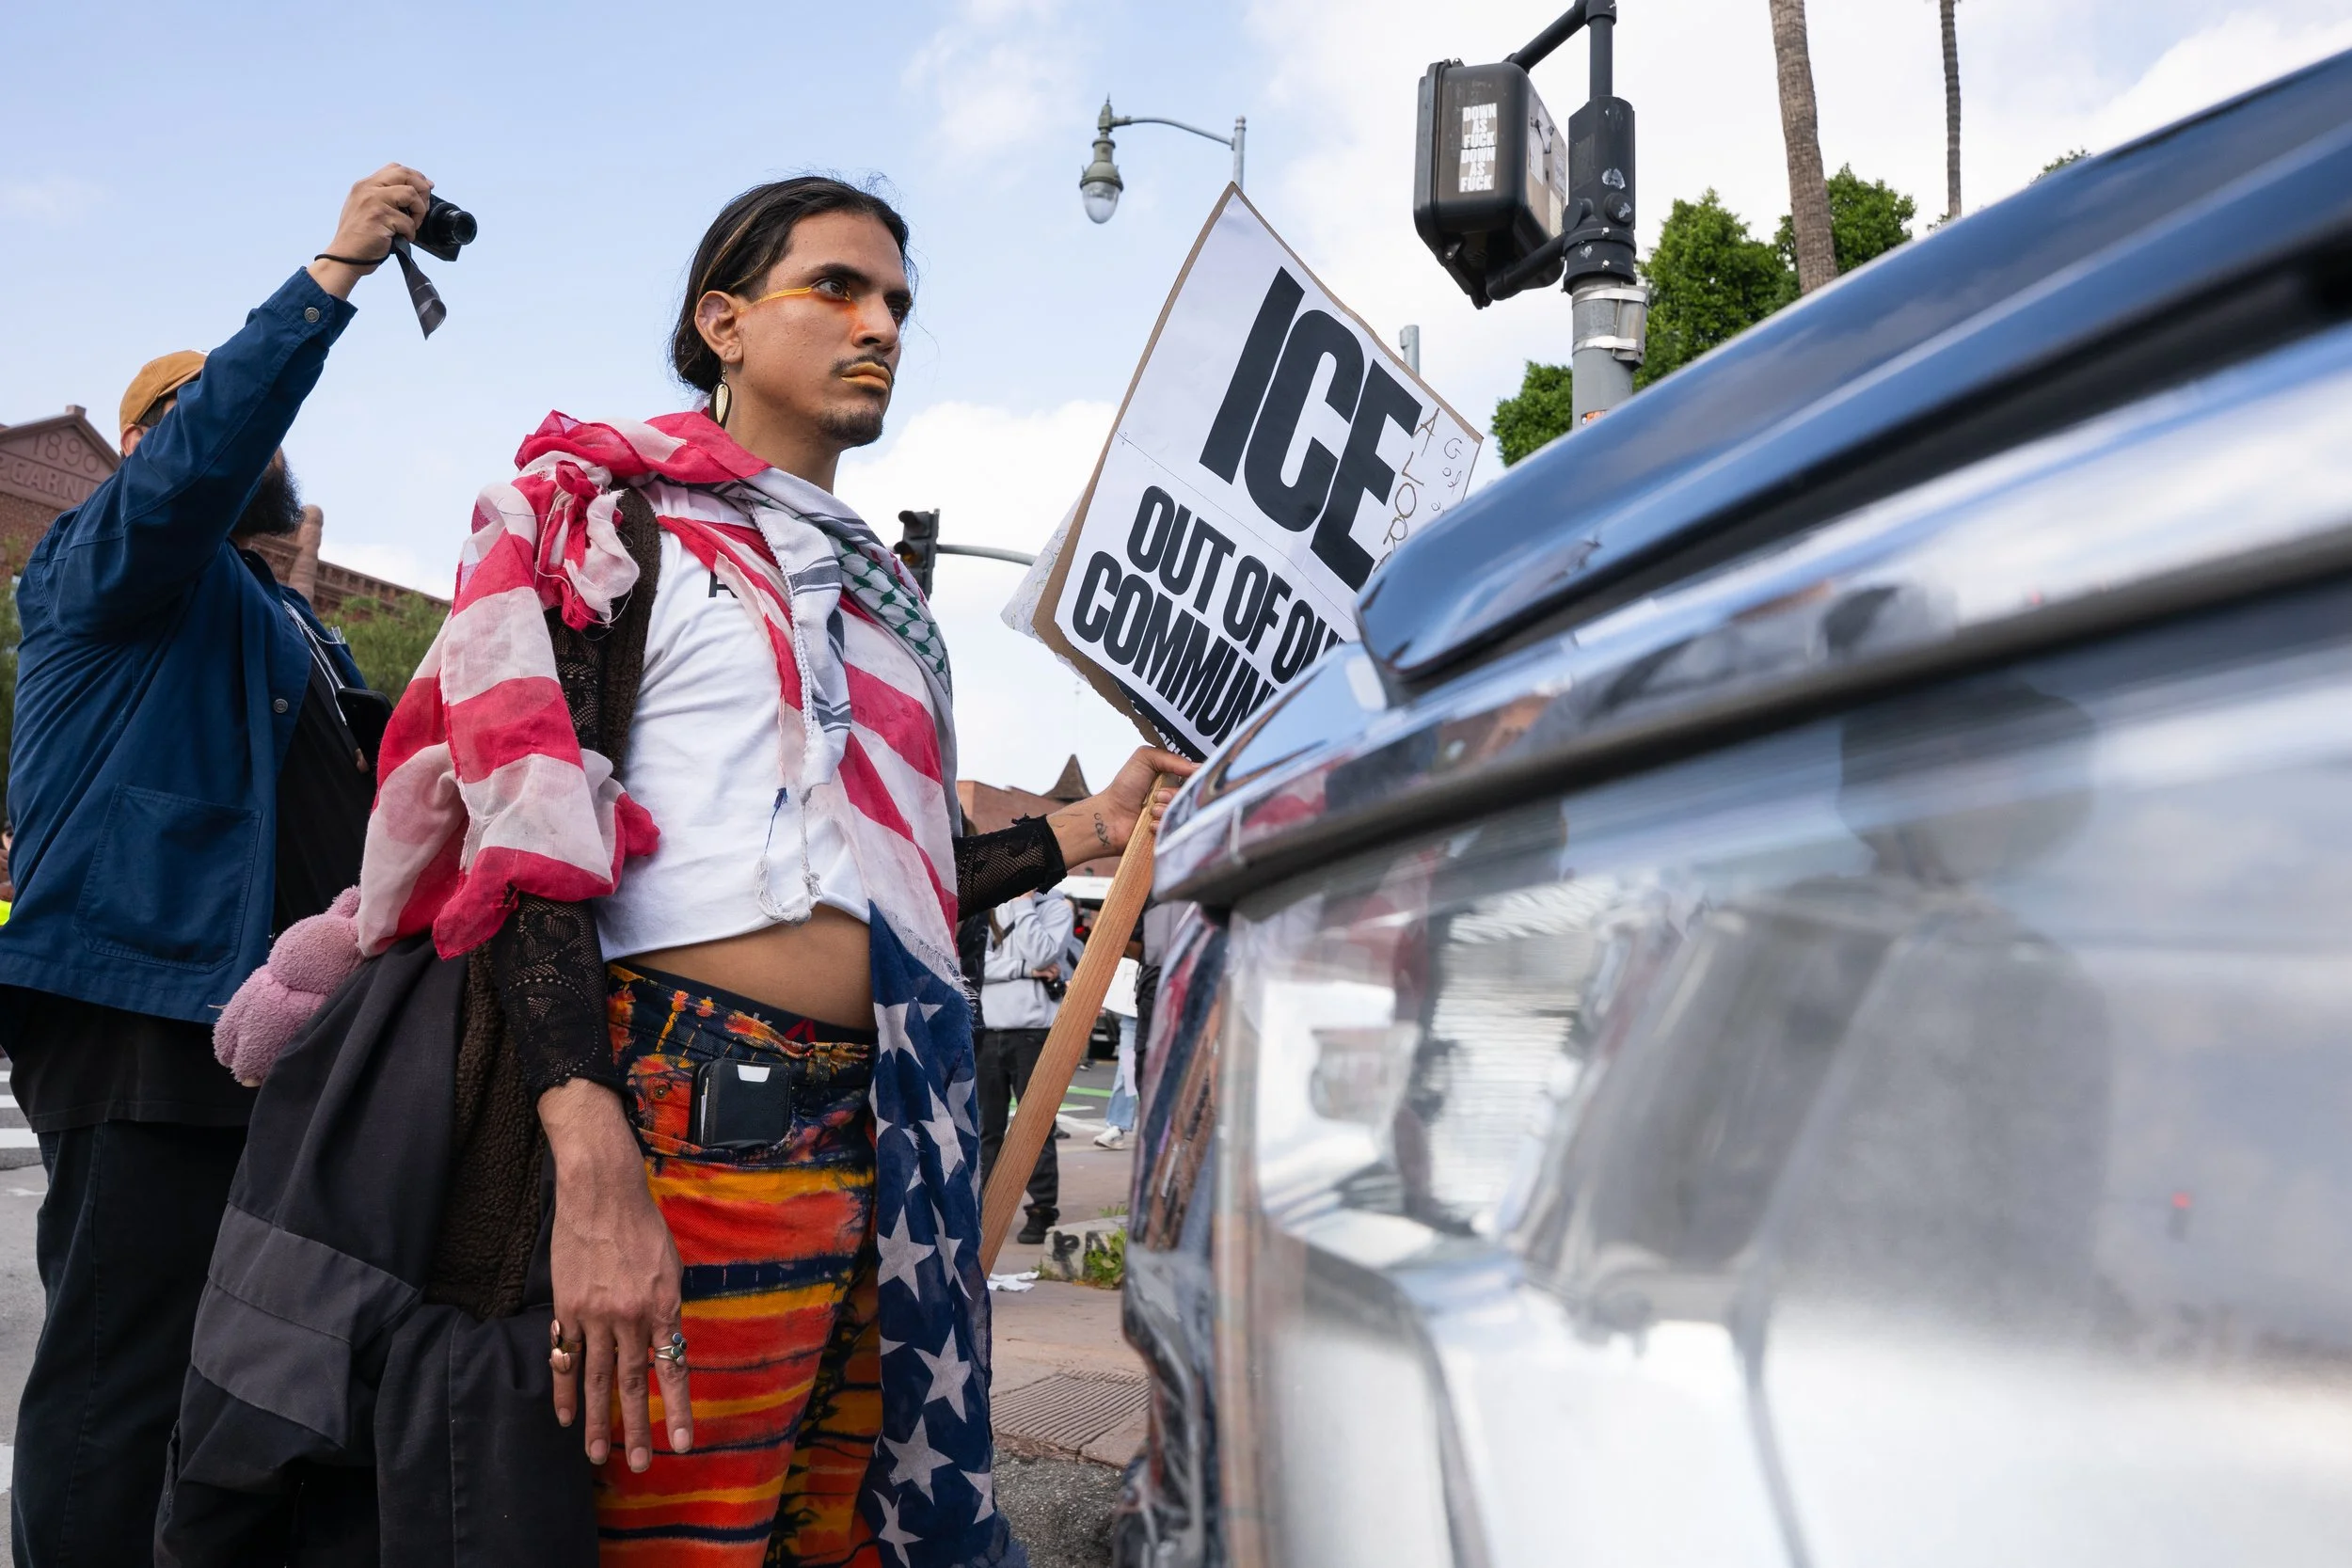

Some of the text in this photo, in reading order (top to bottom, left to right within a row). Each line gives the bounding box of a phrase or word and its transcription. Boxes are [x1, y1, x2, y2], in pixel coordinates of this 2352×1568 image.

[1462, 103, 1497, 121] DOWN
[1471, 119, 1487, 134] AS
[1463, 132, 1495, 149] FUCK
[1460, 147, 1496, 164] DOWN
[1469, 162, 1486, 177] AS
[1459, 175, 1492, 193] FUCK
[1199, 266, 1422, 594] ICE
[34, 432, 99, 473] 1890
[1127, 485, 1347, 685] OUT OF OU
[1073, 550, 1279, 749] COMMUN
